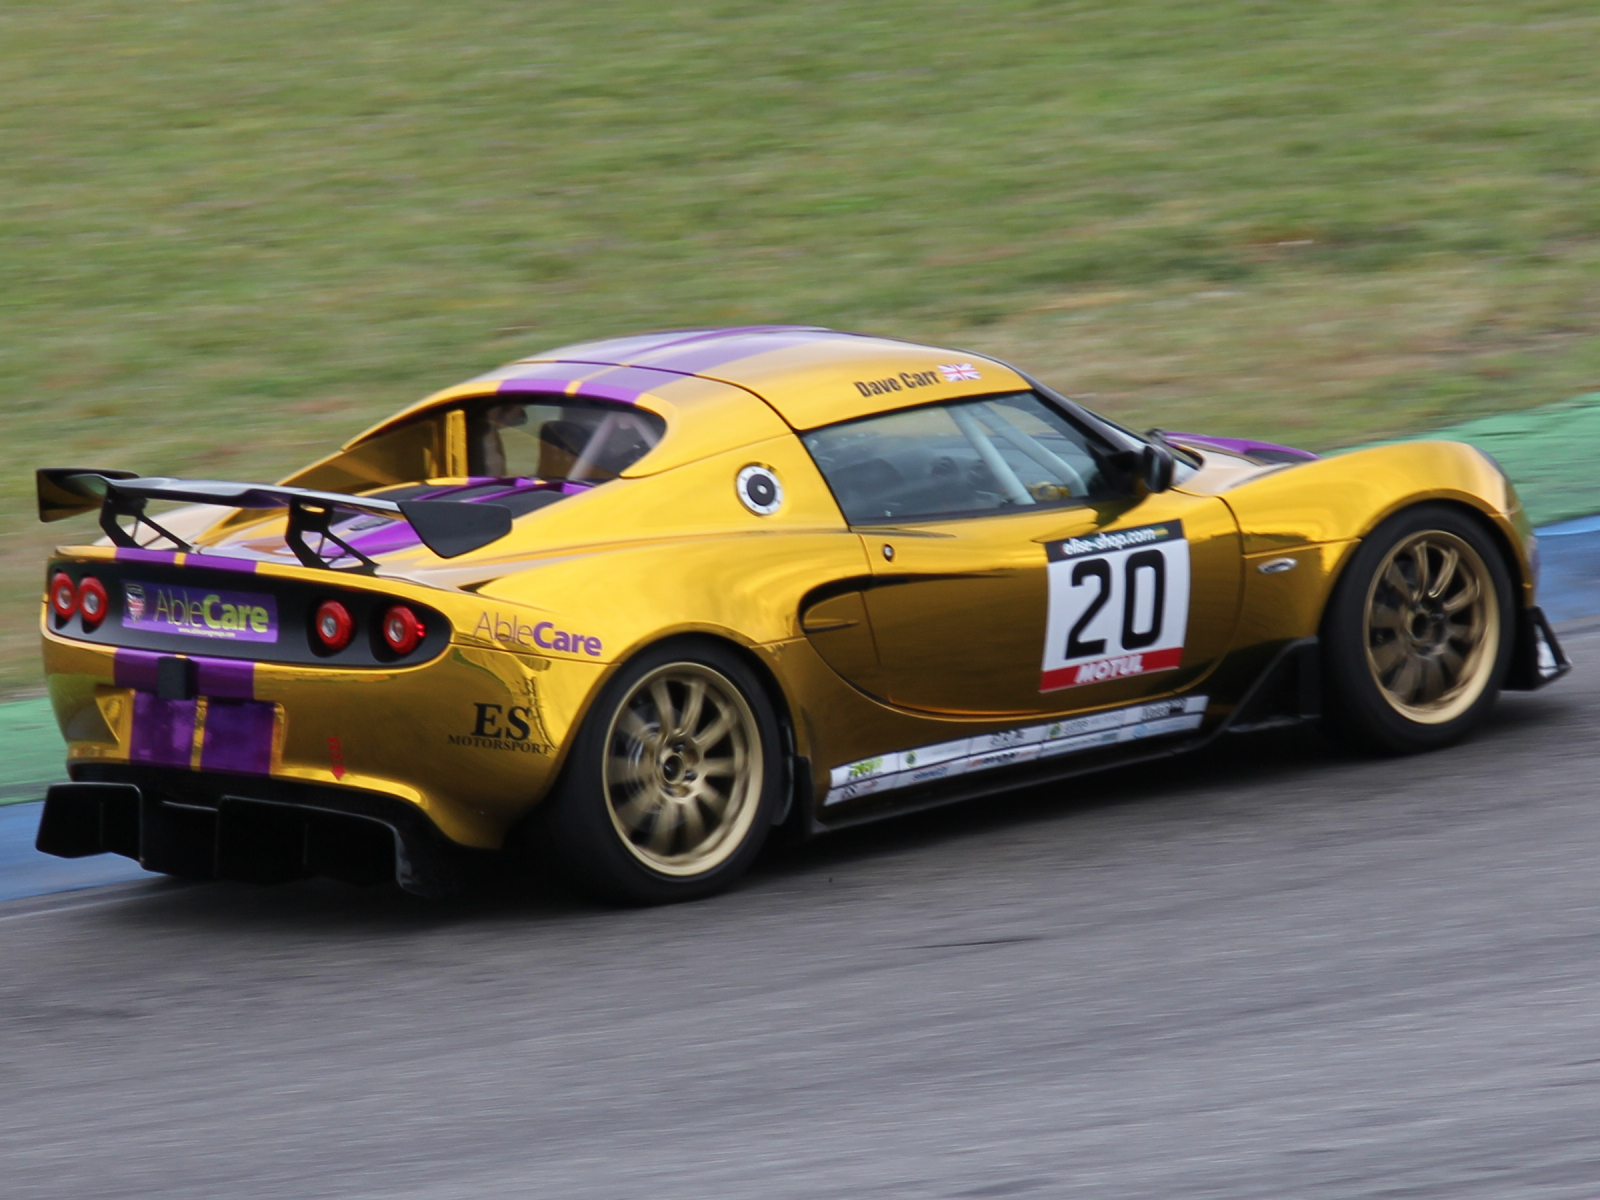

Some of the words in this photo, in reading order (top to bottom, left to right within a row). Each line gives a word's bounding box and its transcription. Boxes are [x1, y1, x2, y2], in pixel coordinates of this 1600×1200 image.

[854, 378, 902, 398] Dave
[899, 371, 940, 389] Carr
[154, 589, 268, 632] AbleCare
[1065, 550, 1165, 660] 20
[473, 612, 602, 656] AbleCare
[1075, 655, 1143, 683] MOTUL
[471, 702, 530, 741] ES
[448, 735, 552, 755] MOTORSPORT
